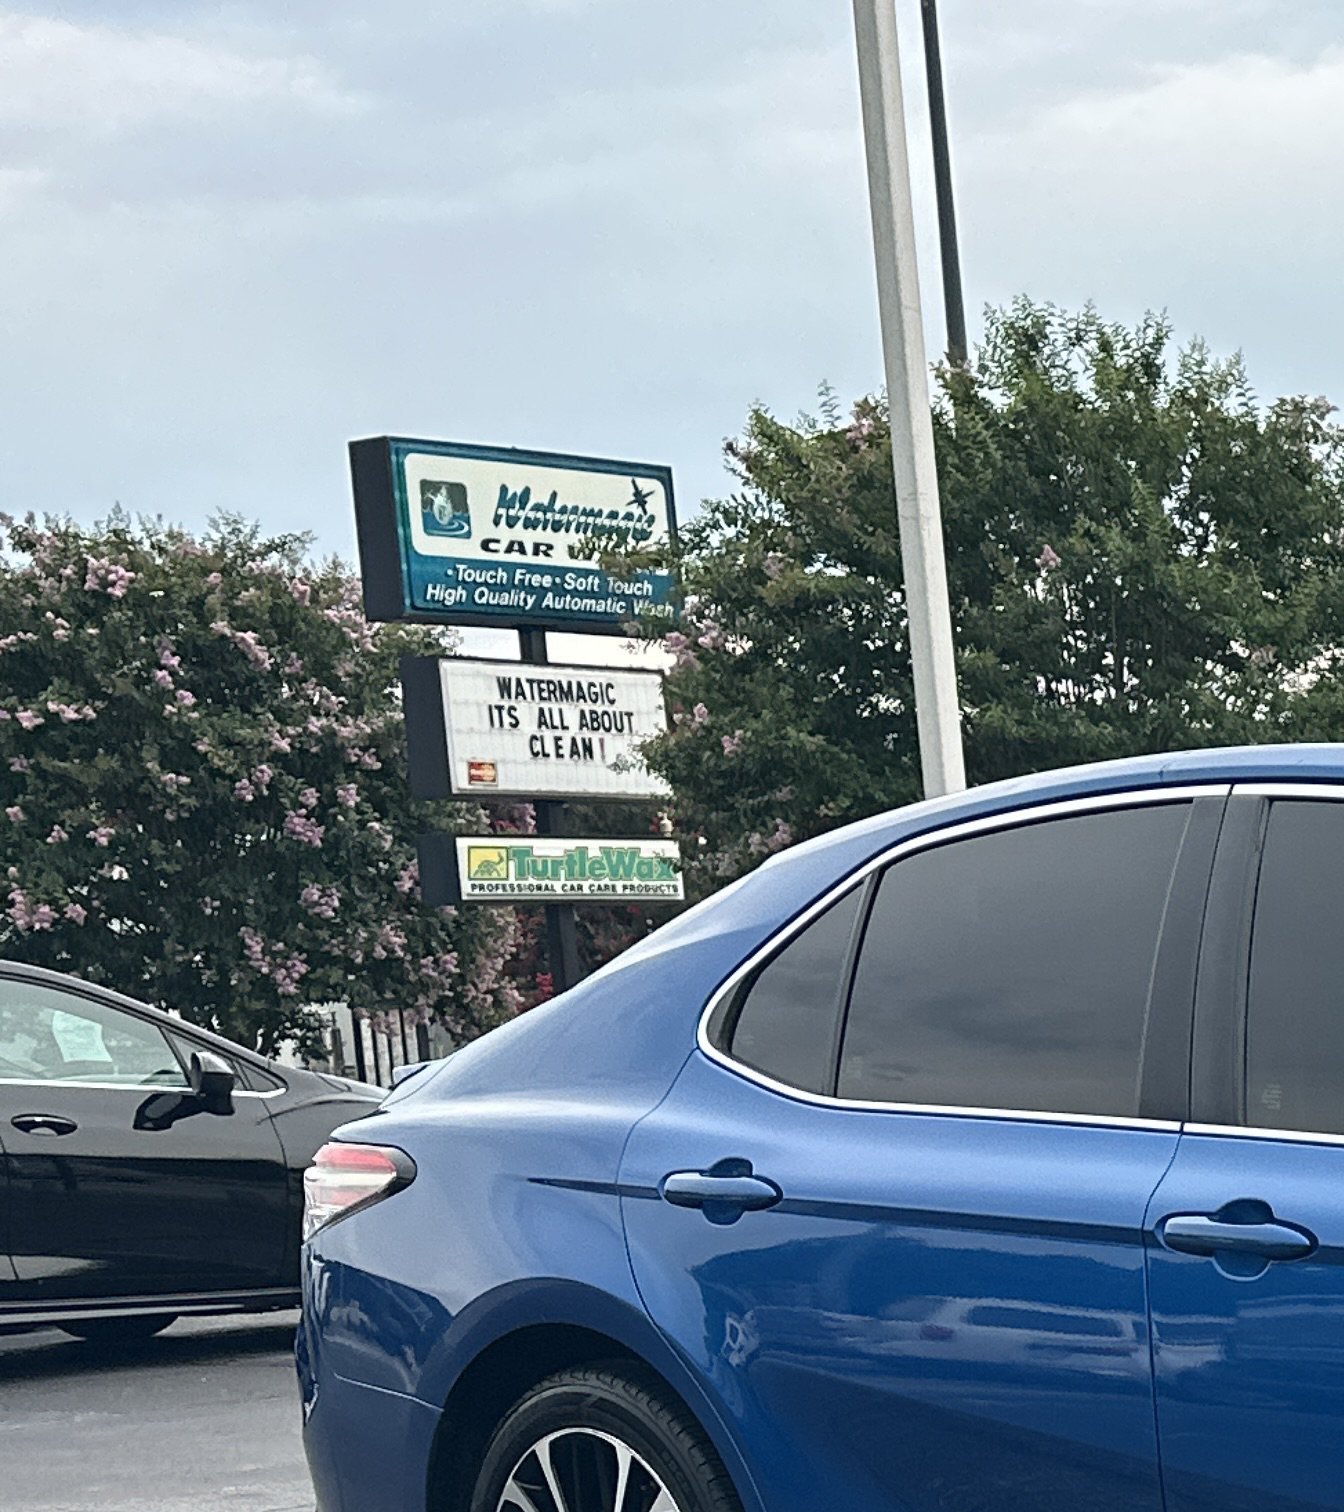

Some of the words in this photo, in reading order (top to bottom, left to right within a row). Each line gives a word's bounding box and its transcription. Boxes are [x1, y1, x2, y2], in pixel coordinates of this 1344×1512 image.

[493, 483, 656, 546] Watermagic
[480, 537, 555, 558] CAR
[455, 565, 507, 584] Touch
[514, 572, 552, 588] Free
[563, 573, 600, 591] Soft
[607, 577, 653, 596] Touch
[426, 583, 466, 605] High
[474, 589, 536, 610] Quality
[541, 593, 626, 614] Automatic
[496, 676, 617, 705] WATERMAGIC
[488, 704, 520, 729] ITS
[537, 707, 569, 731] ALL
[579, 709, 634, 733] ABOUT
[471, 883, 557, 893] PROFESSIONAL
[561, 884, 584, 893] CAR
[588, 884, 617, 894] CARE
[622, 884, 679, 894] PRODUCTS
